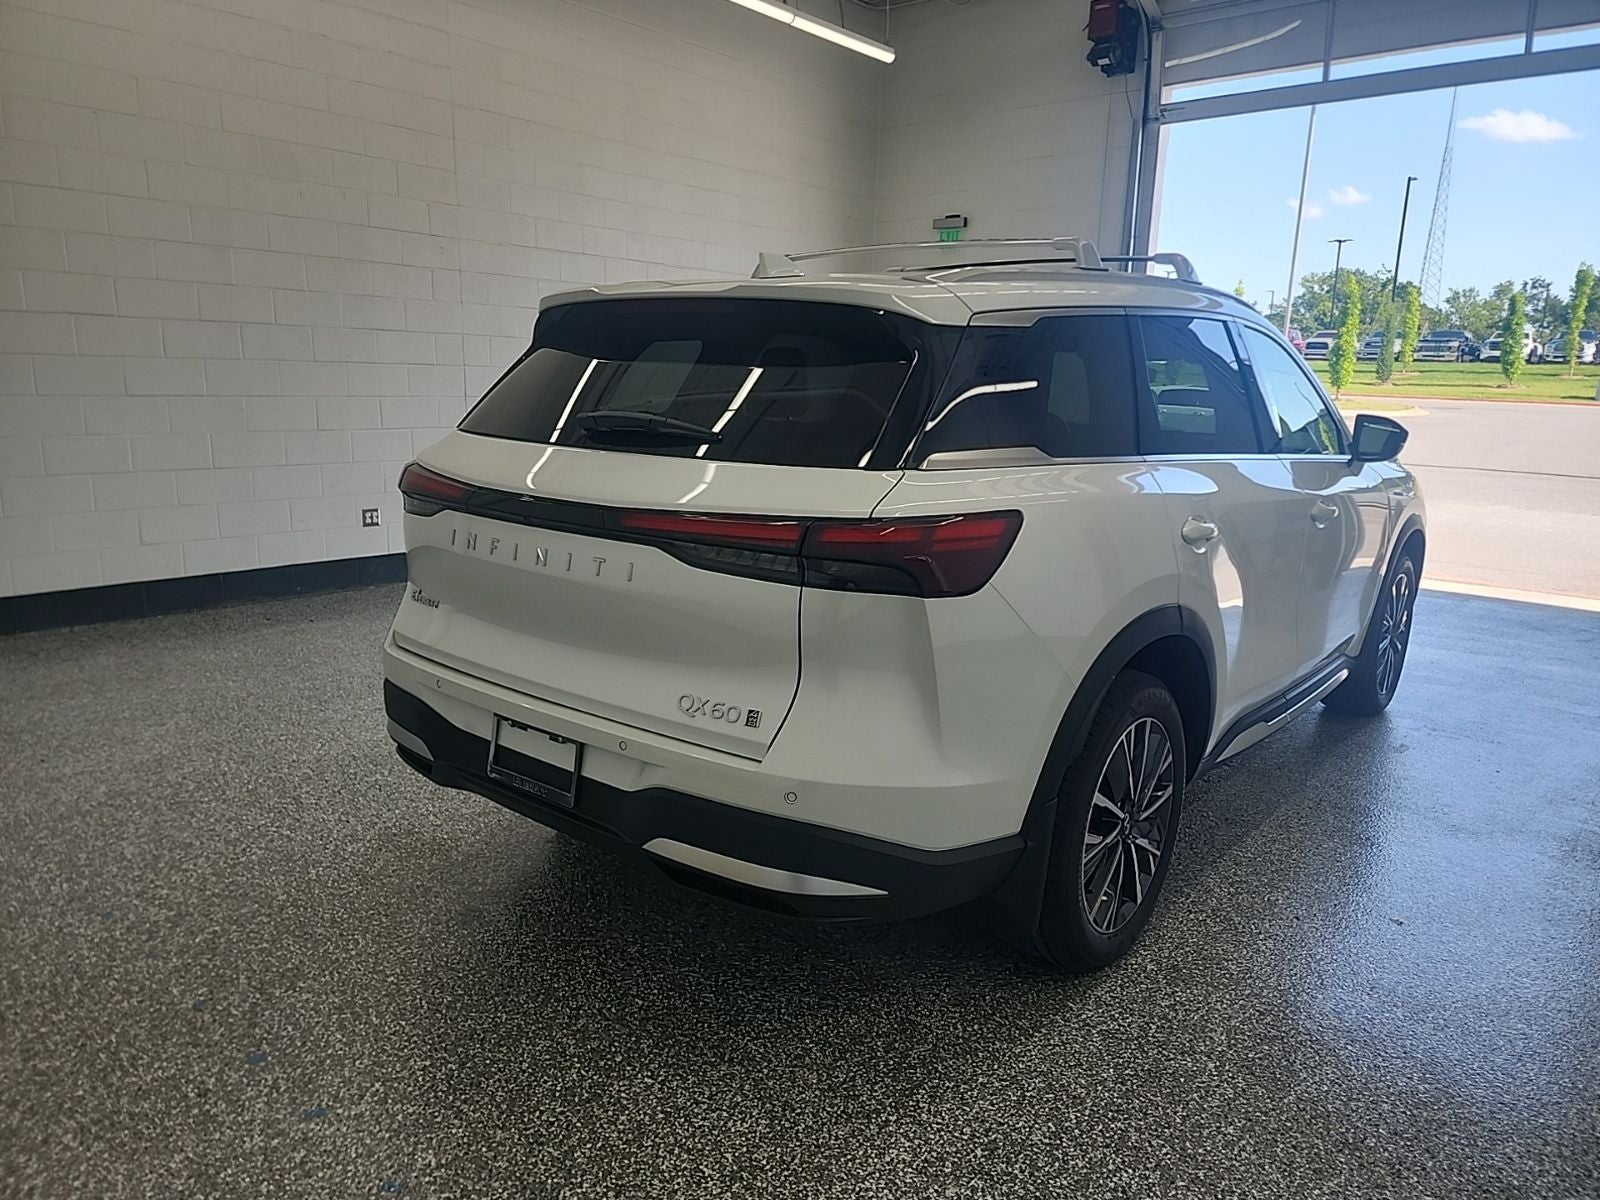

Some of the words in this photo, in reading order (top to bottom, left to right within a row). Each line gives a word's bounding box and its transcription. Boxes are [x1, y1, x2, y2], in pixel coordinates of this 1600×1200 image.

[451, 529, 634, 582] INFINITI
[678, 694, 742, 724] QX60
[746, 709, 760, 727] AWD
